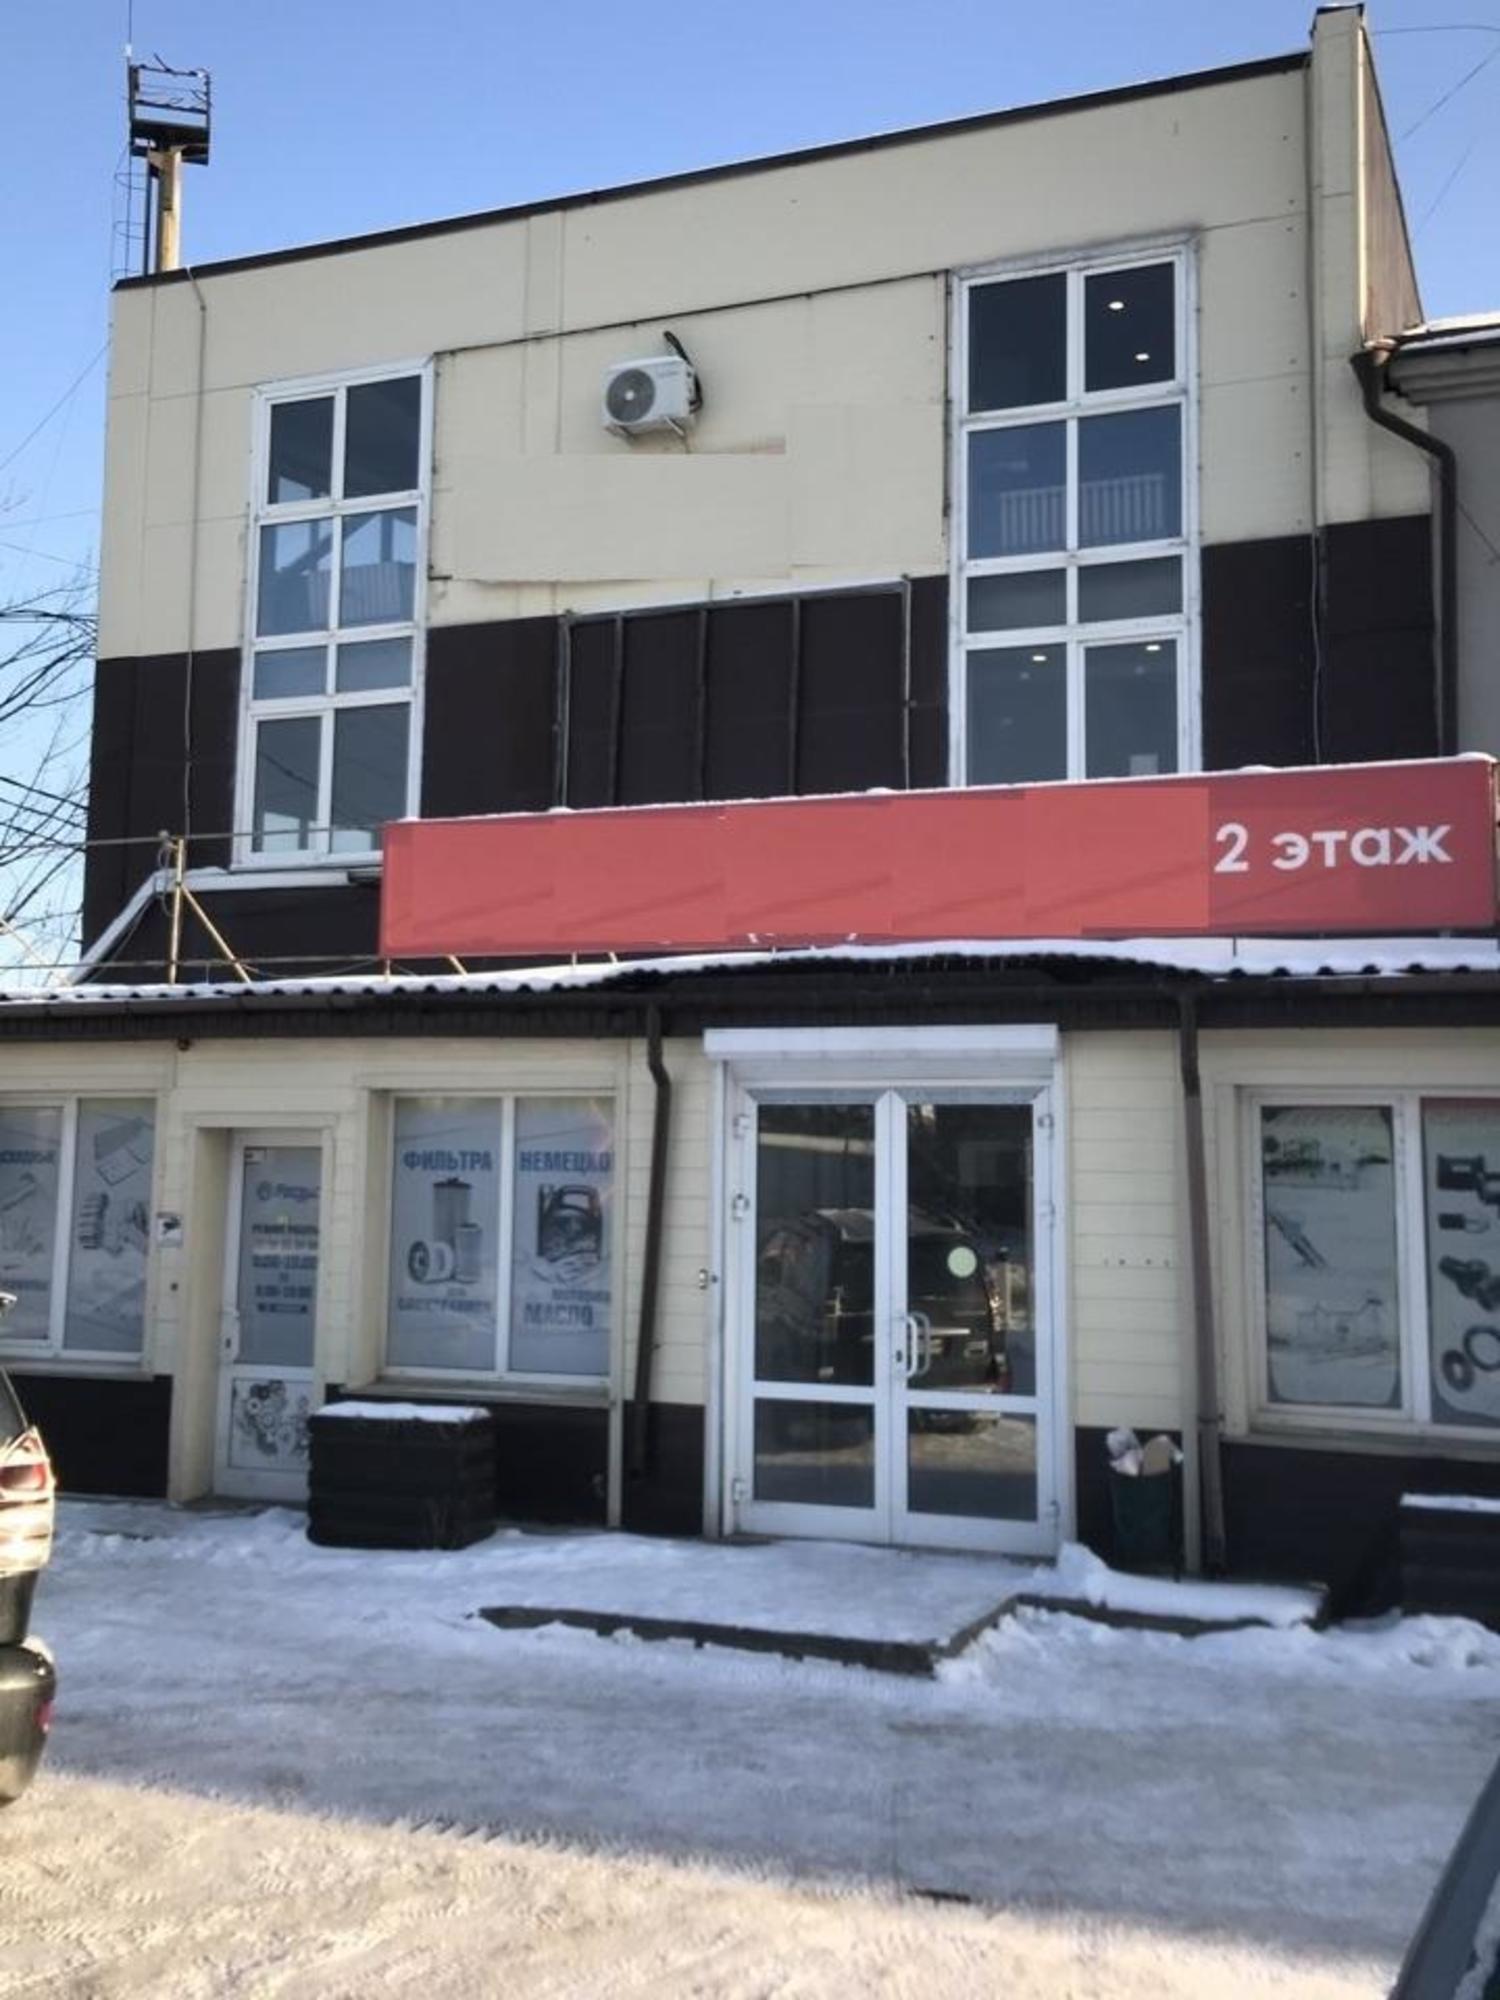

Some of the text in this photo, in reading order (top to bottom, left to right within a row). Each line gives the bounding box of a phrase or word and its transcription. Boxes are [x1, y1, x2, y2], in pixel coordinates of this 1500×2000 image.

[1214, 823, 1454, 873] 2 этаж
[403, 1150, 493, 1171] ФИЛЬТРА
[524, 1302, 594, 1327] МАСЛО
